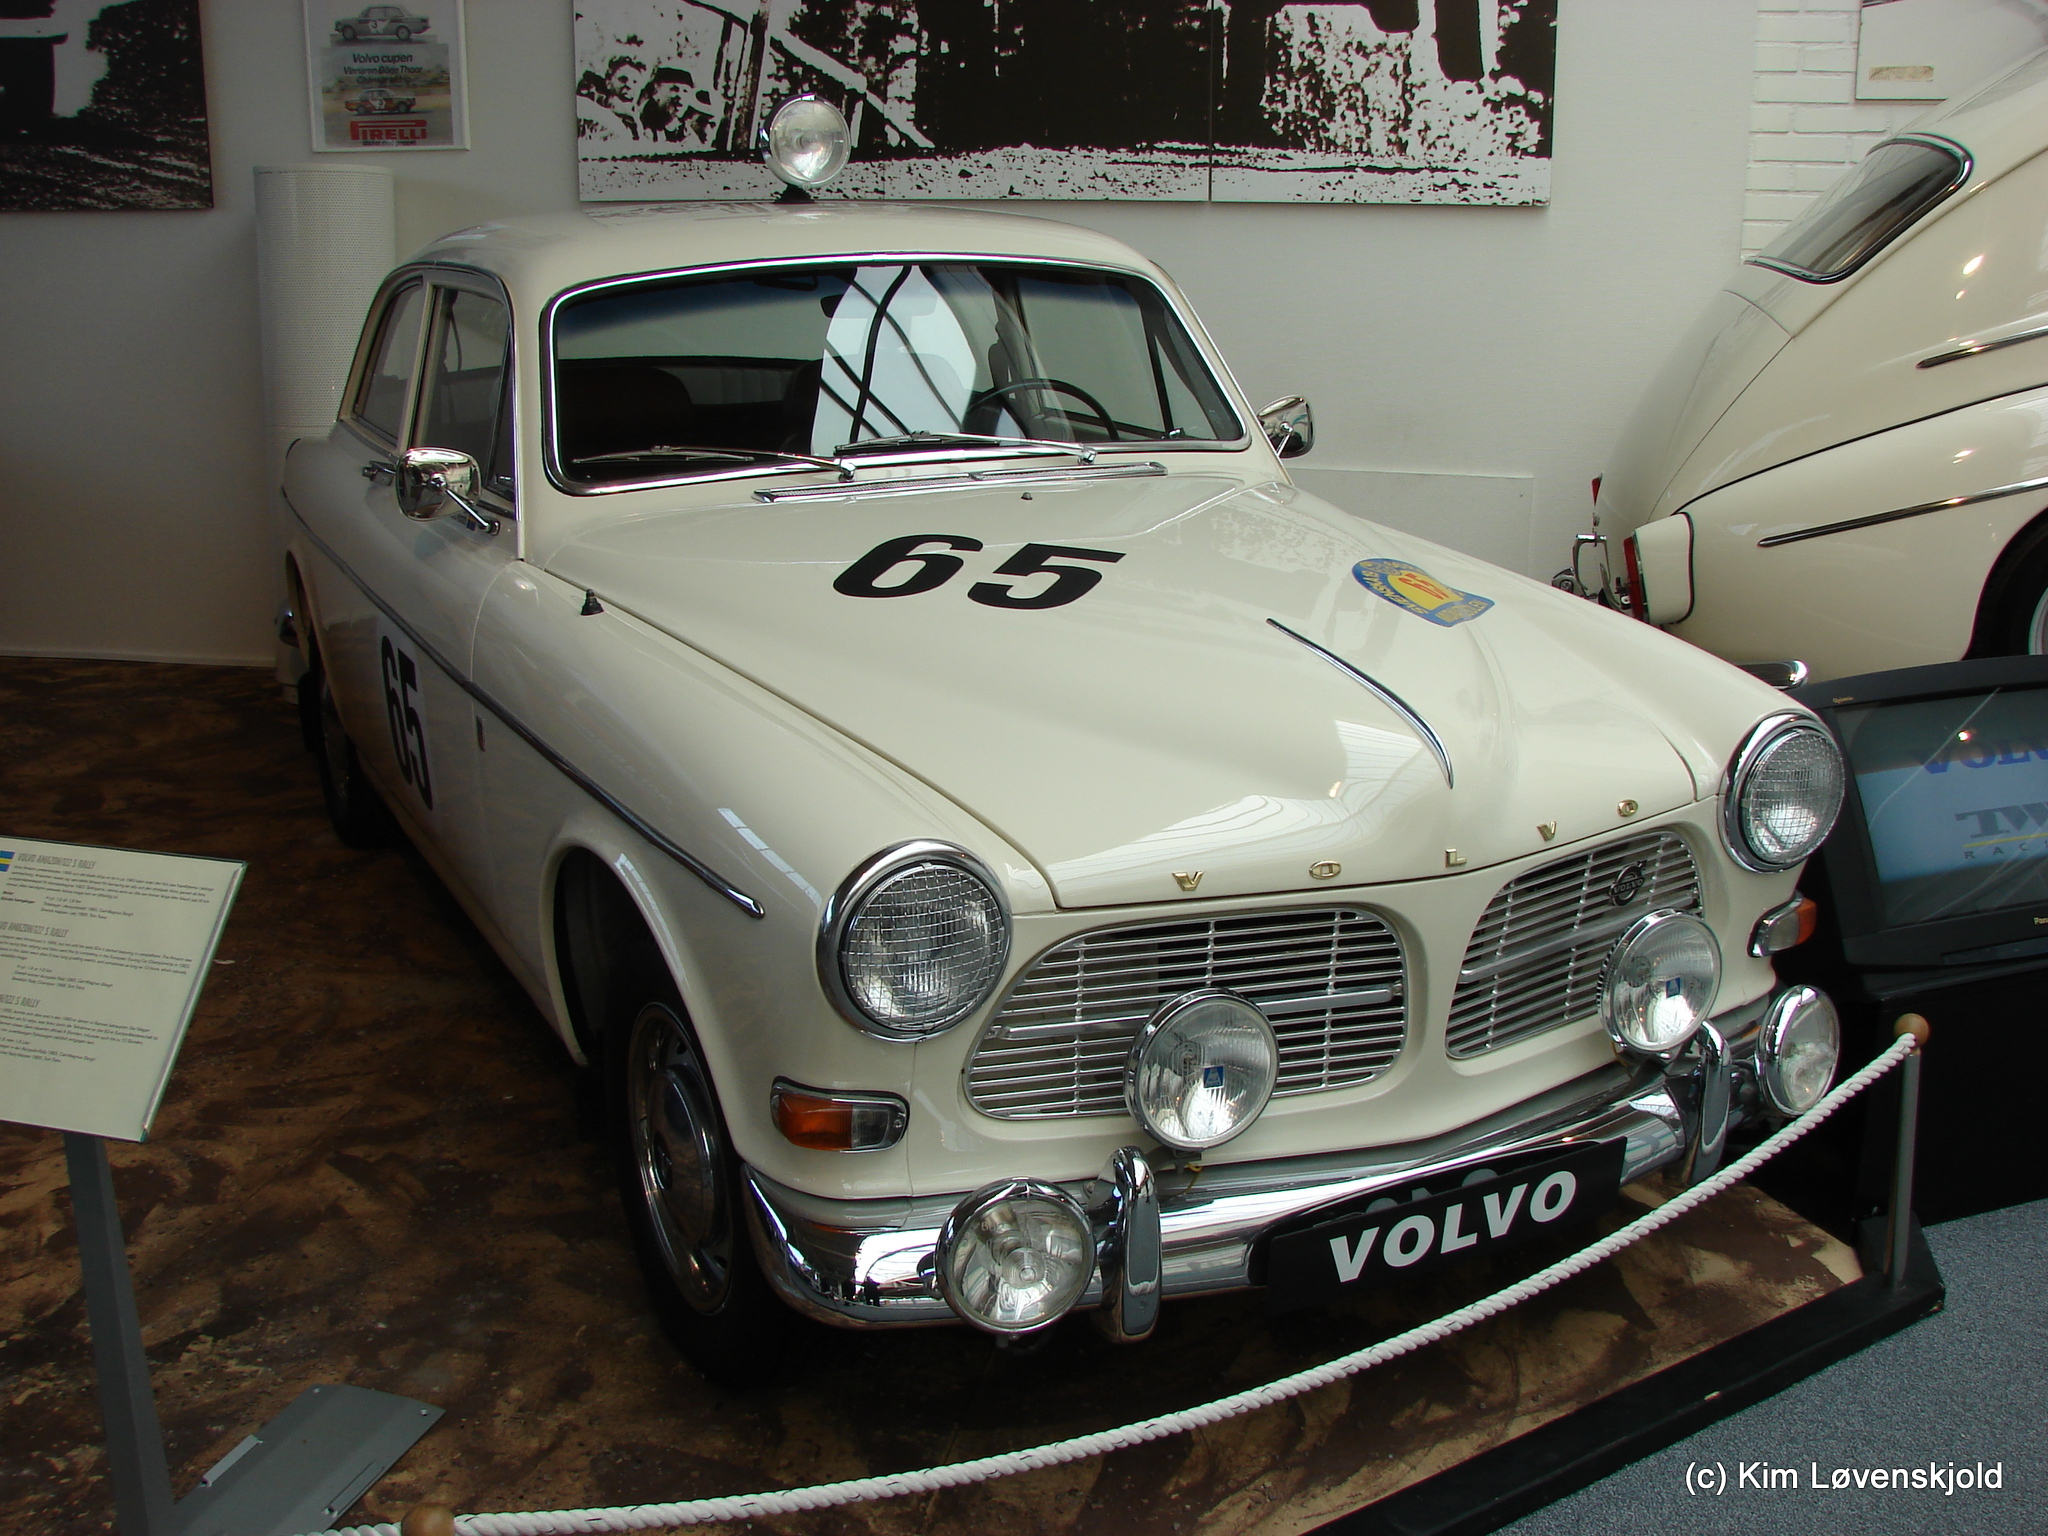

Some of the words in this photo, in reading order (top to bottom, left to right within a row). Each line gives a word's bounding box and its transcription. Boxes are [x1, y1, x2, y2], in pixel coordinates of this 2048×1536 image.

[352, 53, 380, 63] Volvo
[381, 53, 413, 65] cupen
[350, 119, 428, 140] PIRELLI
[833, 533, 1127, 611] 65
[381, 635, 433, 811] 65
[1172, 799, 1639, 892] VOLVO
[1613, 877, 1645, 894] VOLVO
[1329, 1170, 1577, 1283] VOLVO
